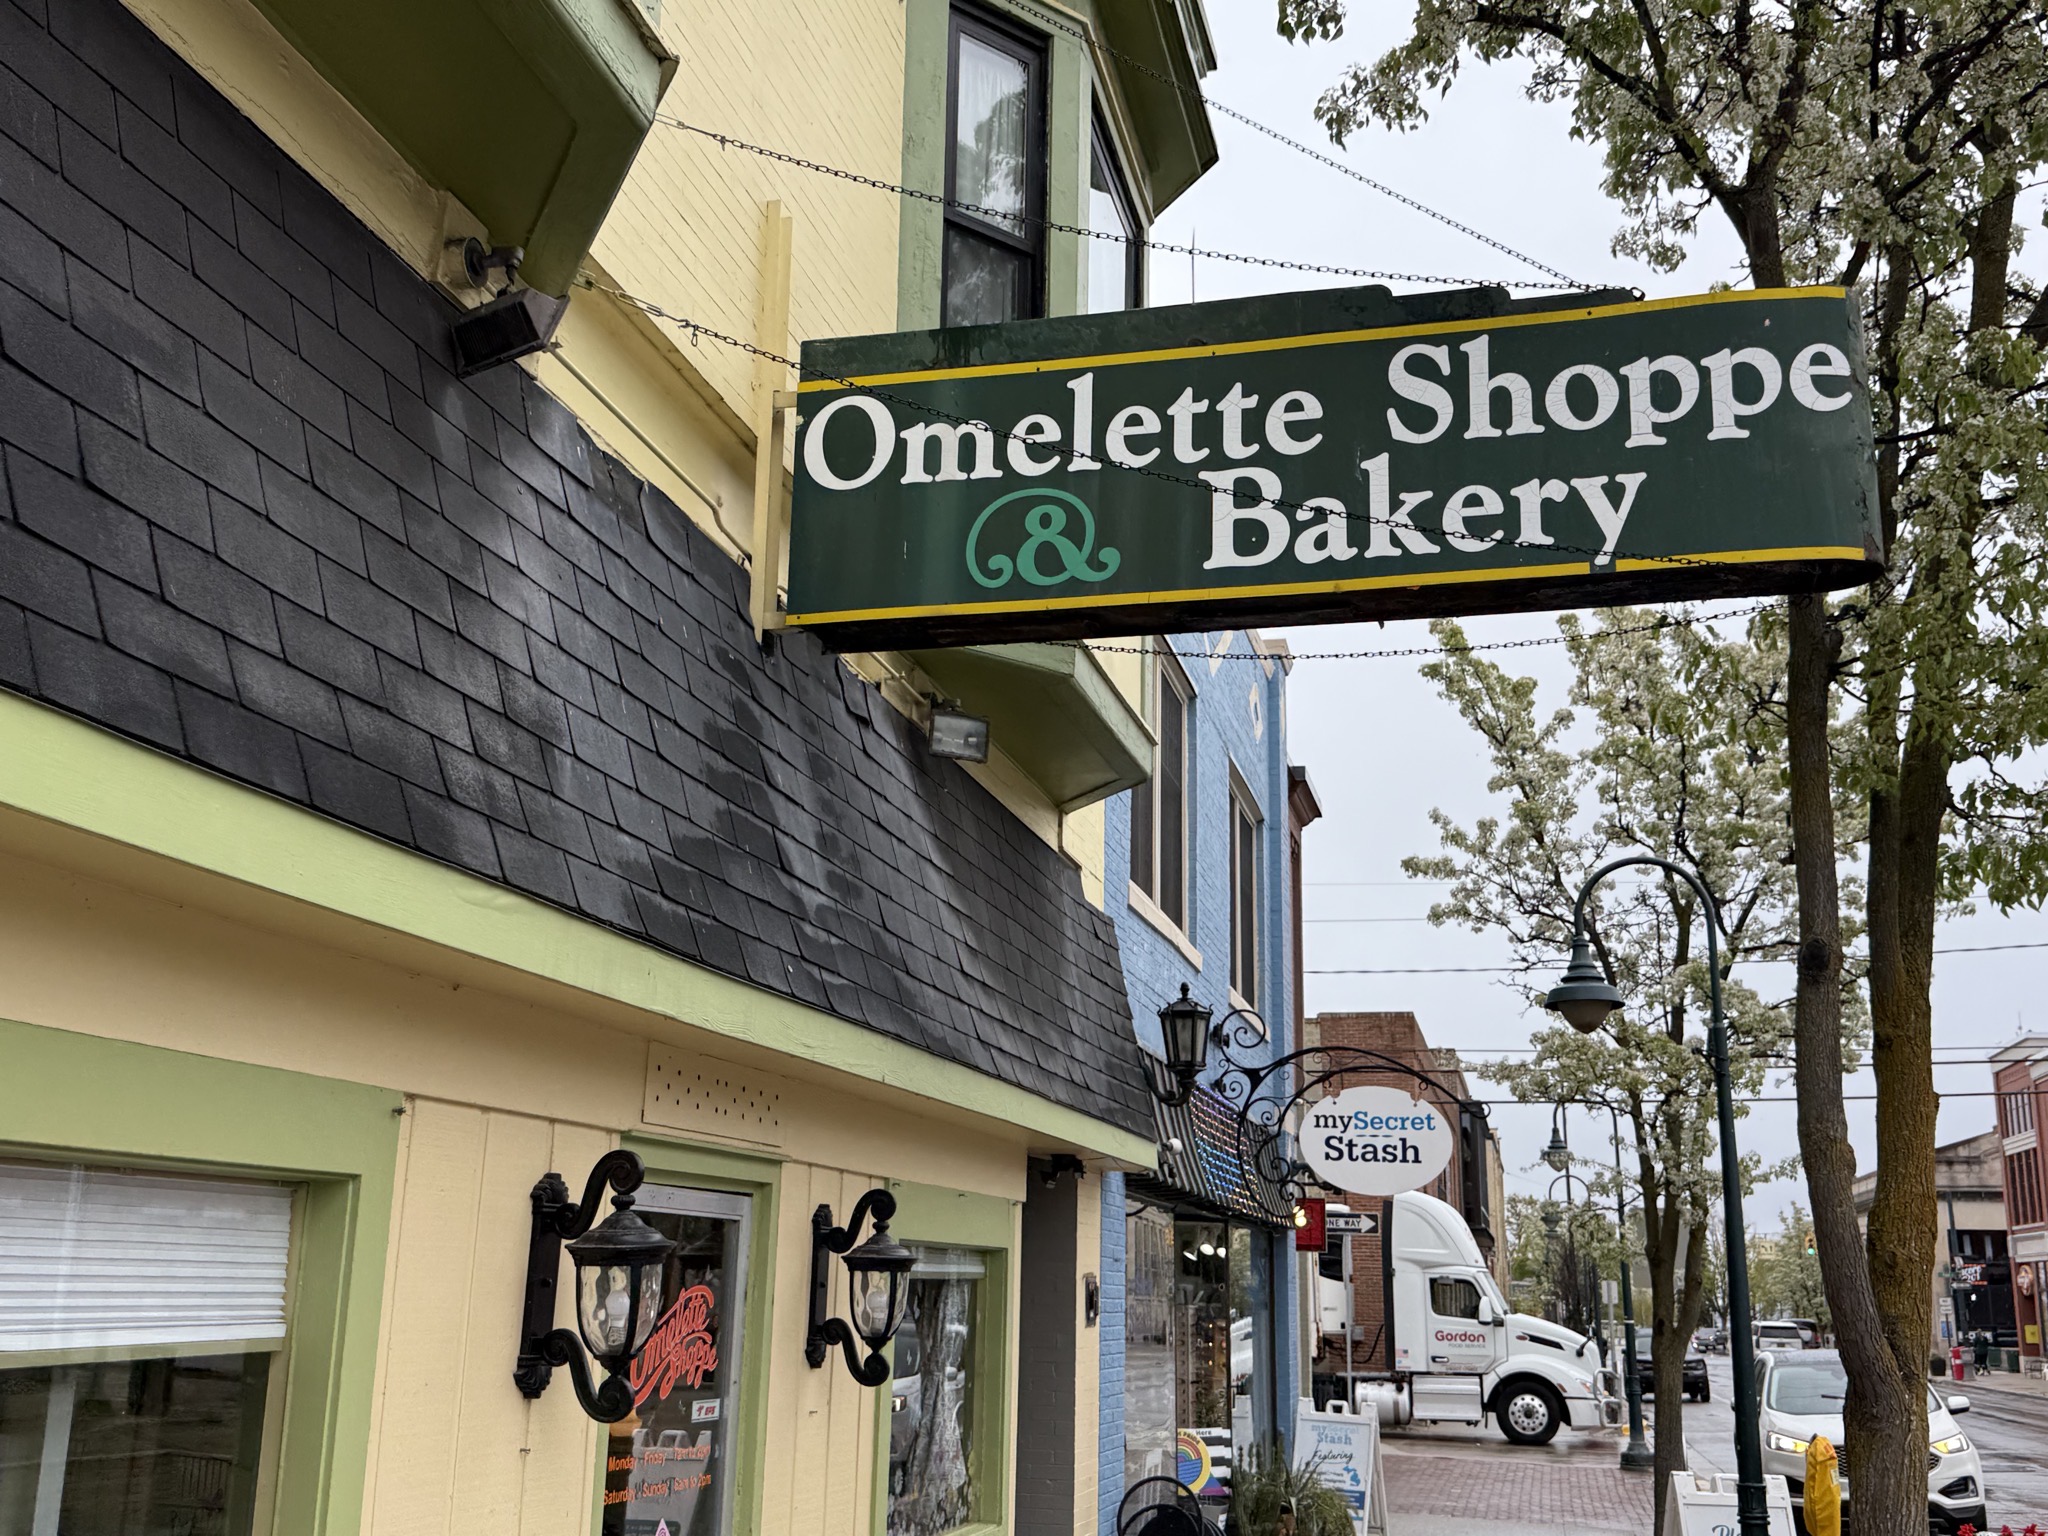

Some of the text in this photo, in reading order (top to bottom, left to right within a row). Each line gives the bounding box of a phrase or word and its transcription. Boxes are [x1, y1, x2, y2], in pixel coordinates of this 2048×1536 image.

[802, 333, 1853, 490] Omelette Shoppe
[966, 451, 1647, 589] & Bakery
[1313, 1110, 1436, 1134] mySecret
[1324, 1135, 1422, 1164] Stash
[1344, 1218, 1361, 1227] WAY
[1435, 1329, 1486, 1343] Gordon
[1317, 1431, 1352, 1446] Stash
[608, 1456, 637, 1472] Monday
[604, 1487, 636, 1505] Saturday
[643, 1481, 669, 1498] Sunday
